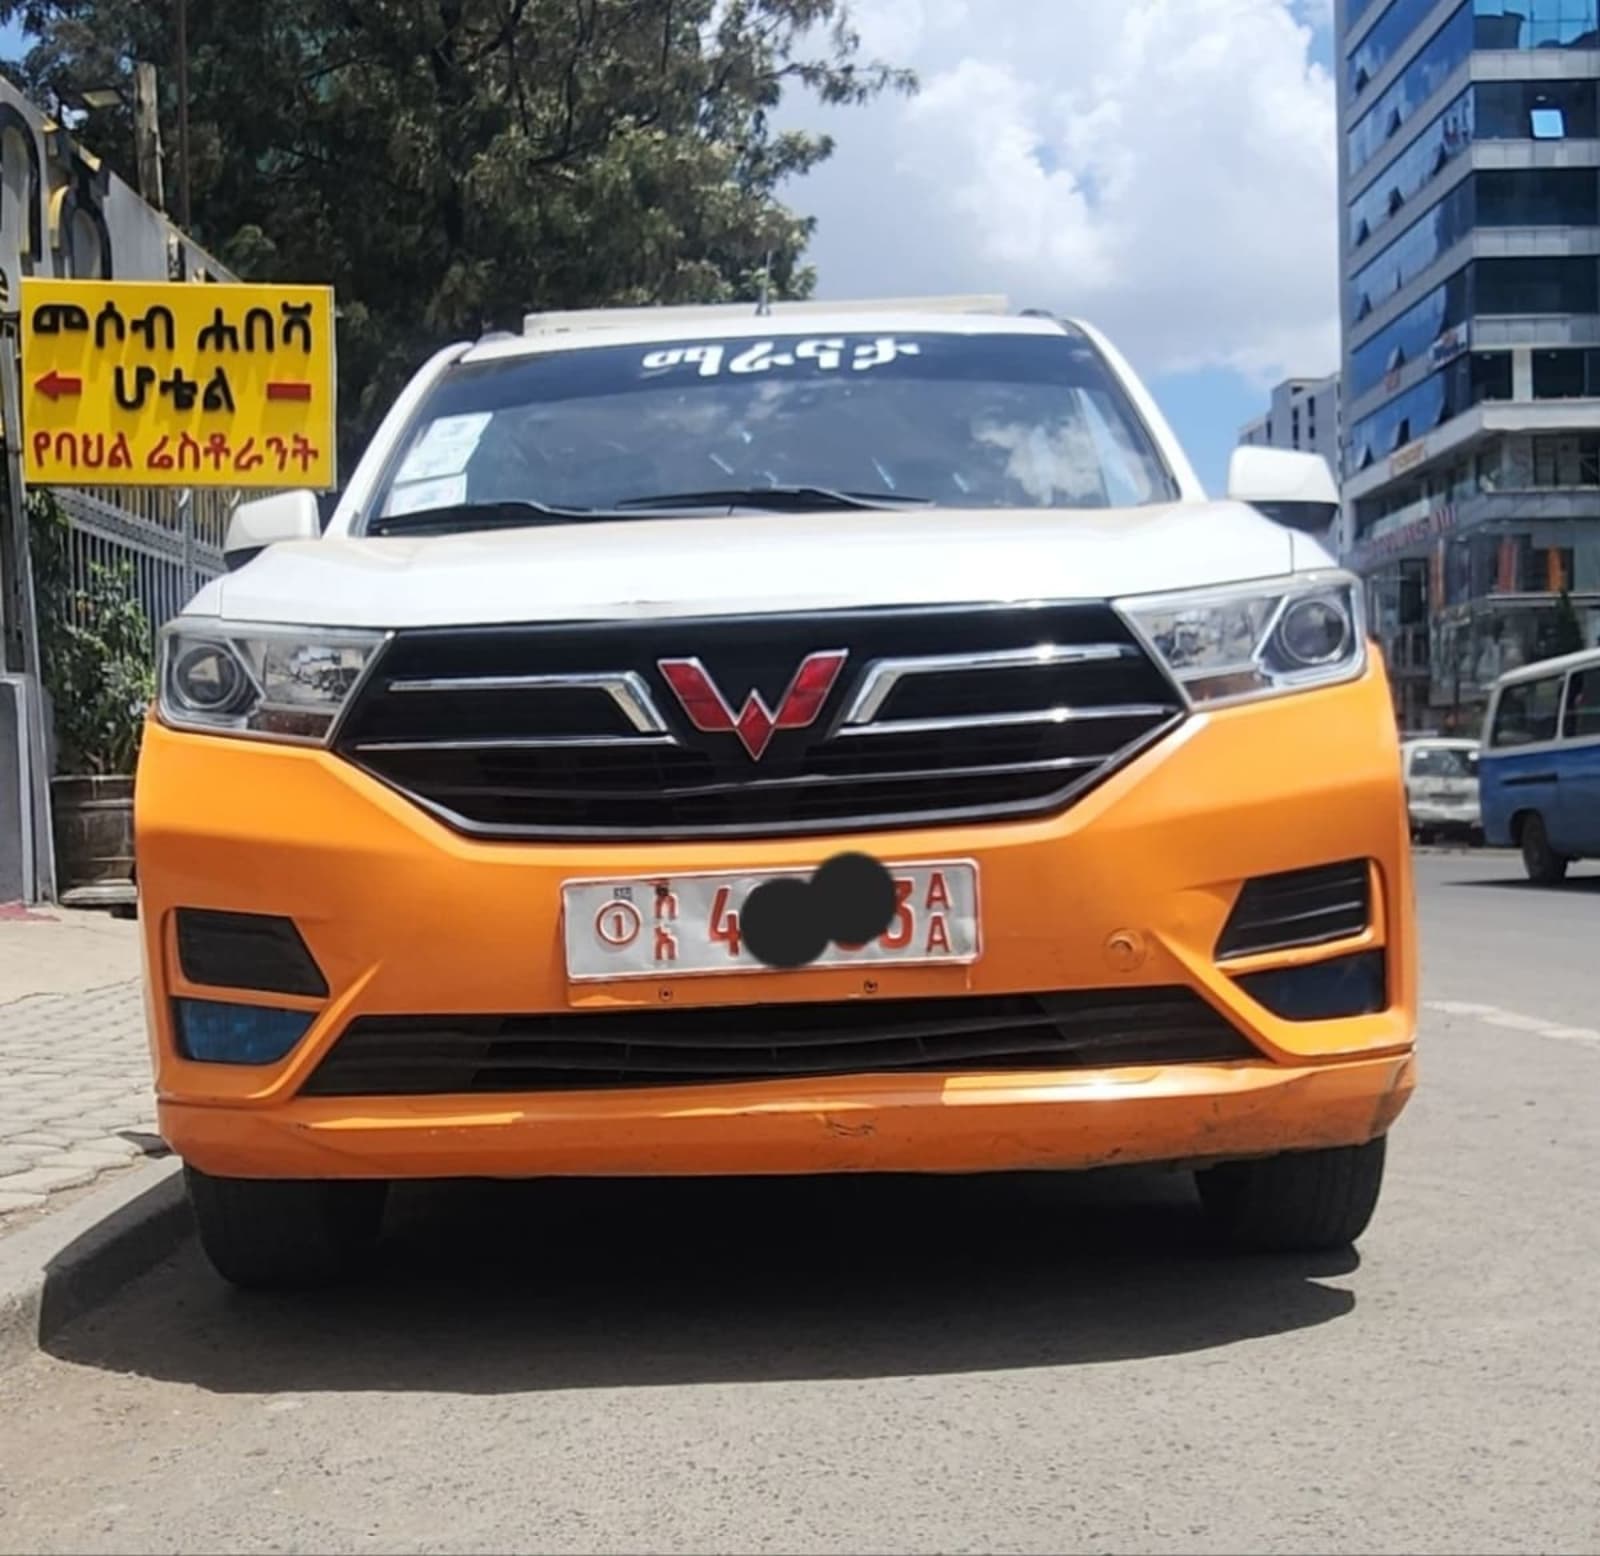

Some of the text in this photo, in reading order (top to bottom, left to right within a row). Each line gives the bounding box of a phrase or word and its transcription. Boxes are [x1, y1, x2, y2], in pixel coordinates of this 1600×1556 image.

[32, 301, 313, 354] መሶብ ሐበሻ
[114, 366, 236, 413] ሆቴል
[33, 431, 319, 472] የባህል ሬስቶራንት
